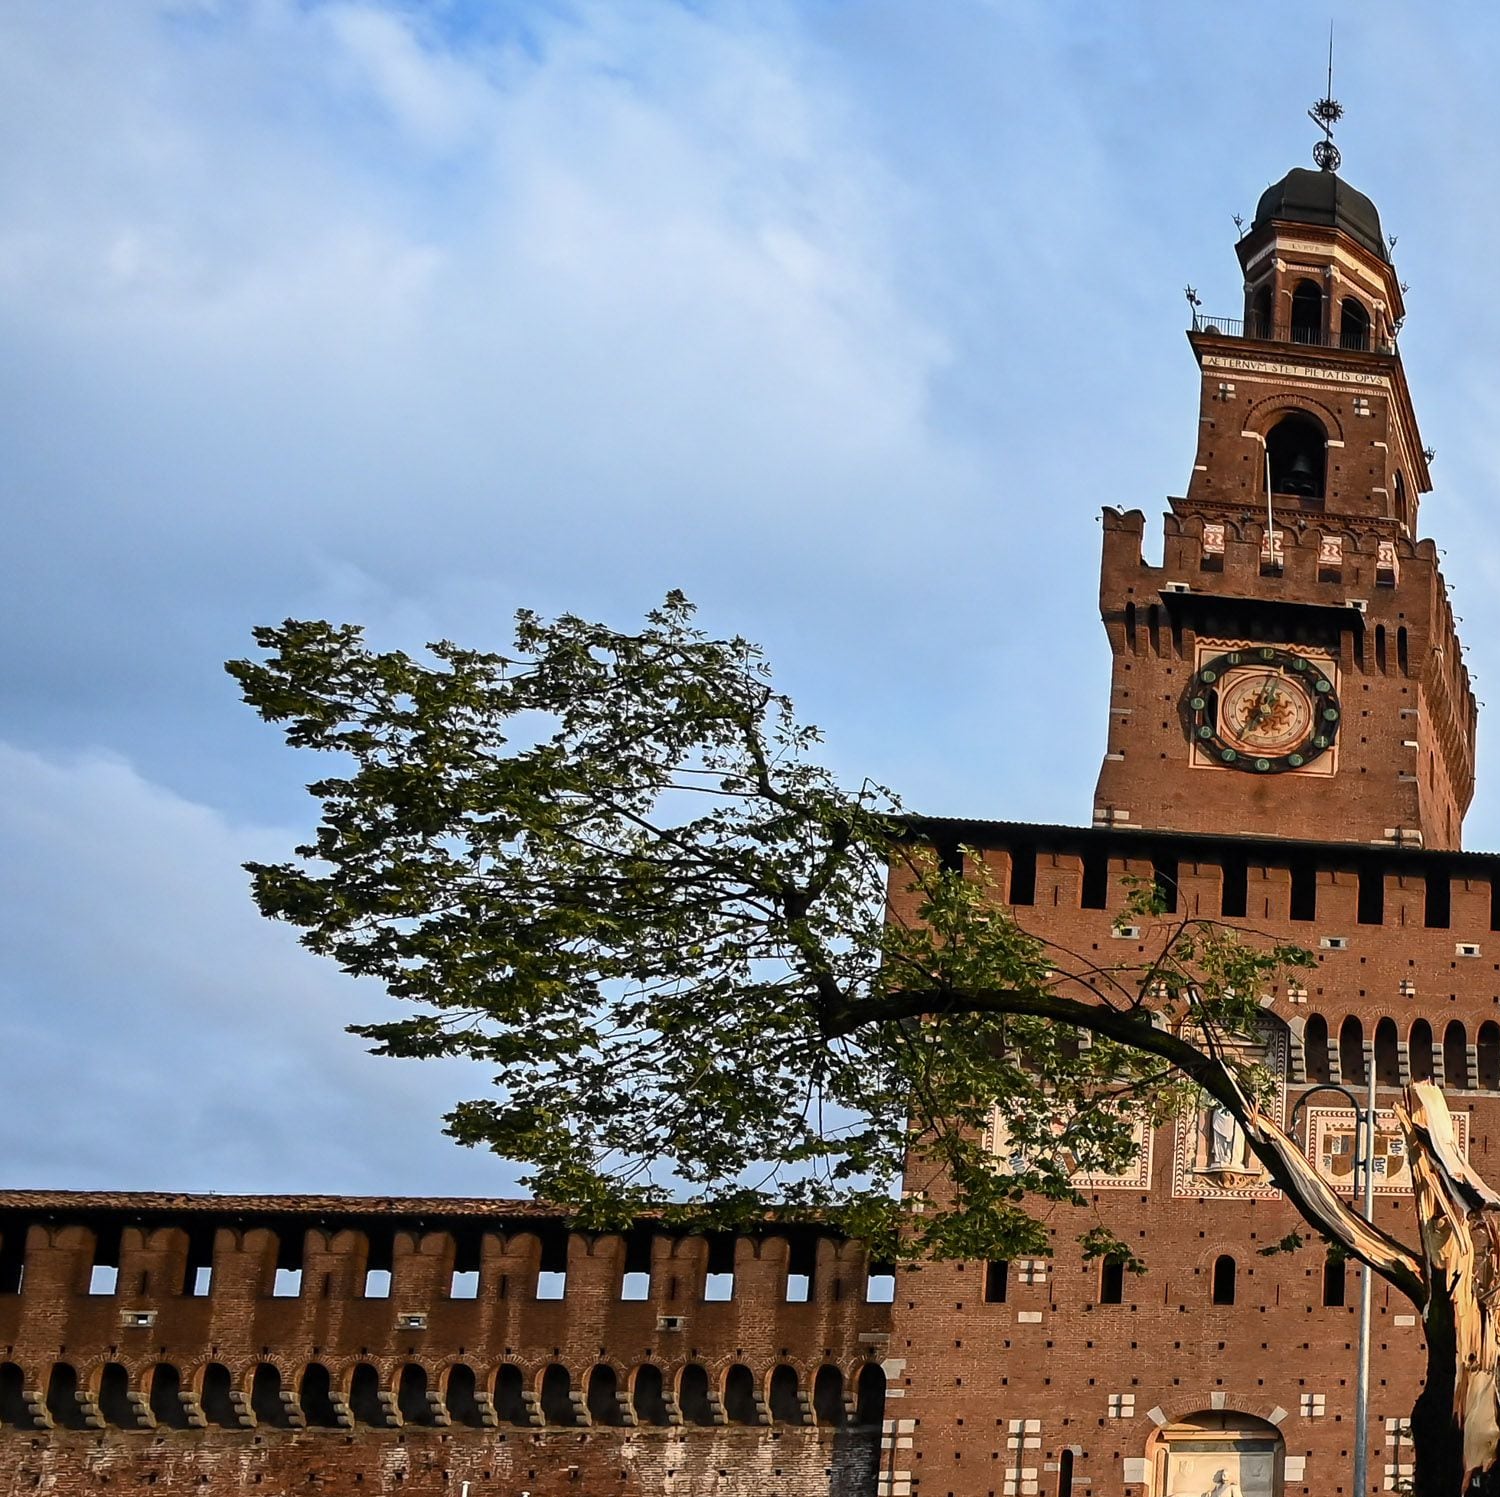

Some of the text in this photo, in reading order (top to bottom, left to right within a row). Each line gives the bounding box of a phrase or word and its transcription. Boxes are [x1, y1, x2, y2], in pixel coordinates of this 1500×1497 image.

[1230, 654, 1239, 664] 11
[1263, 648, 1274, 659] 12
[1193, 698, 1204, 709] 9
[1201, 726, 1211, 738] 8
[1315, 736, 1326, 747] 4
[1224, 749, 1235, 760] 7
[1257, 759, 1269, 770] 6
